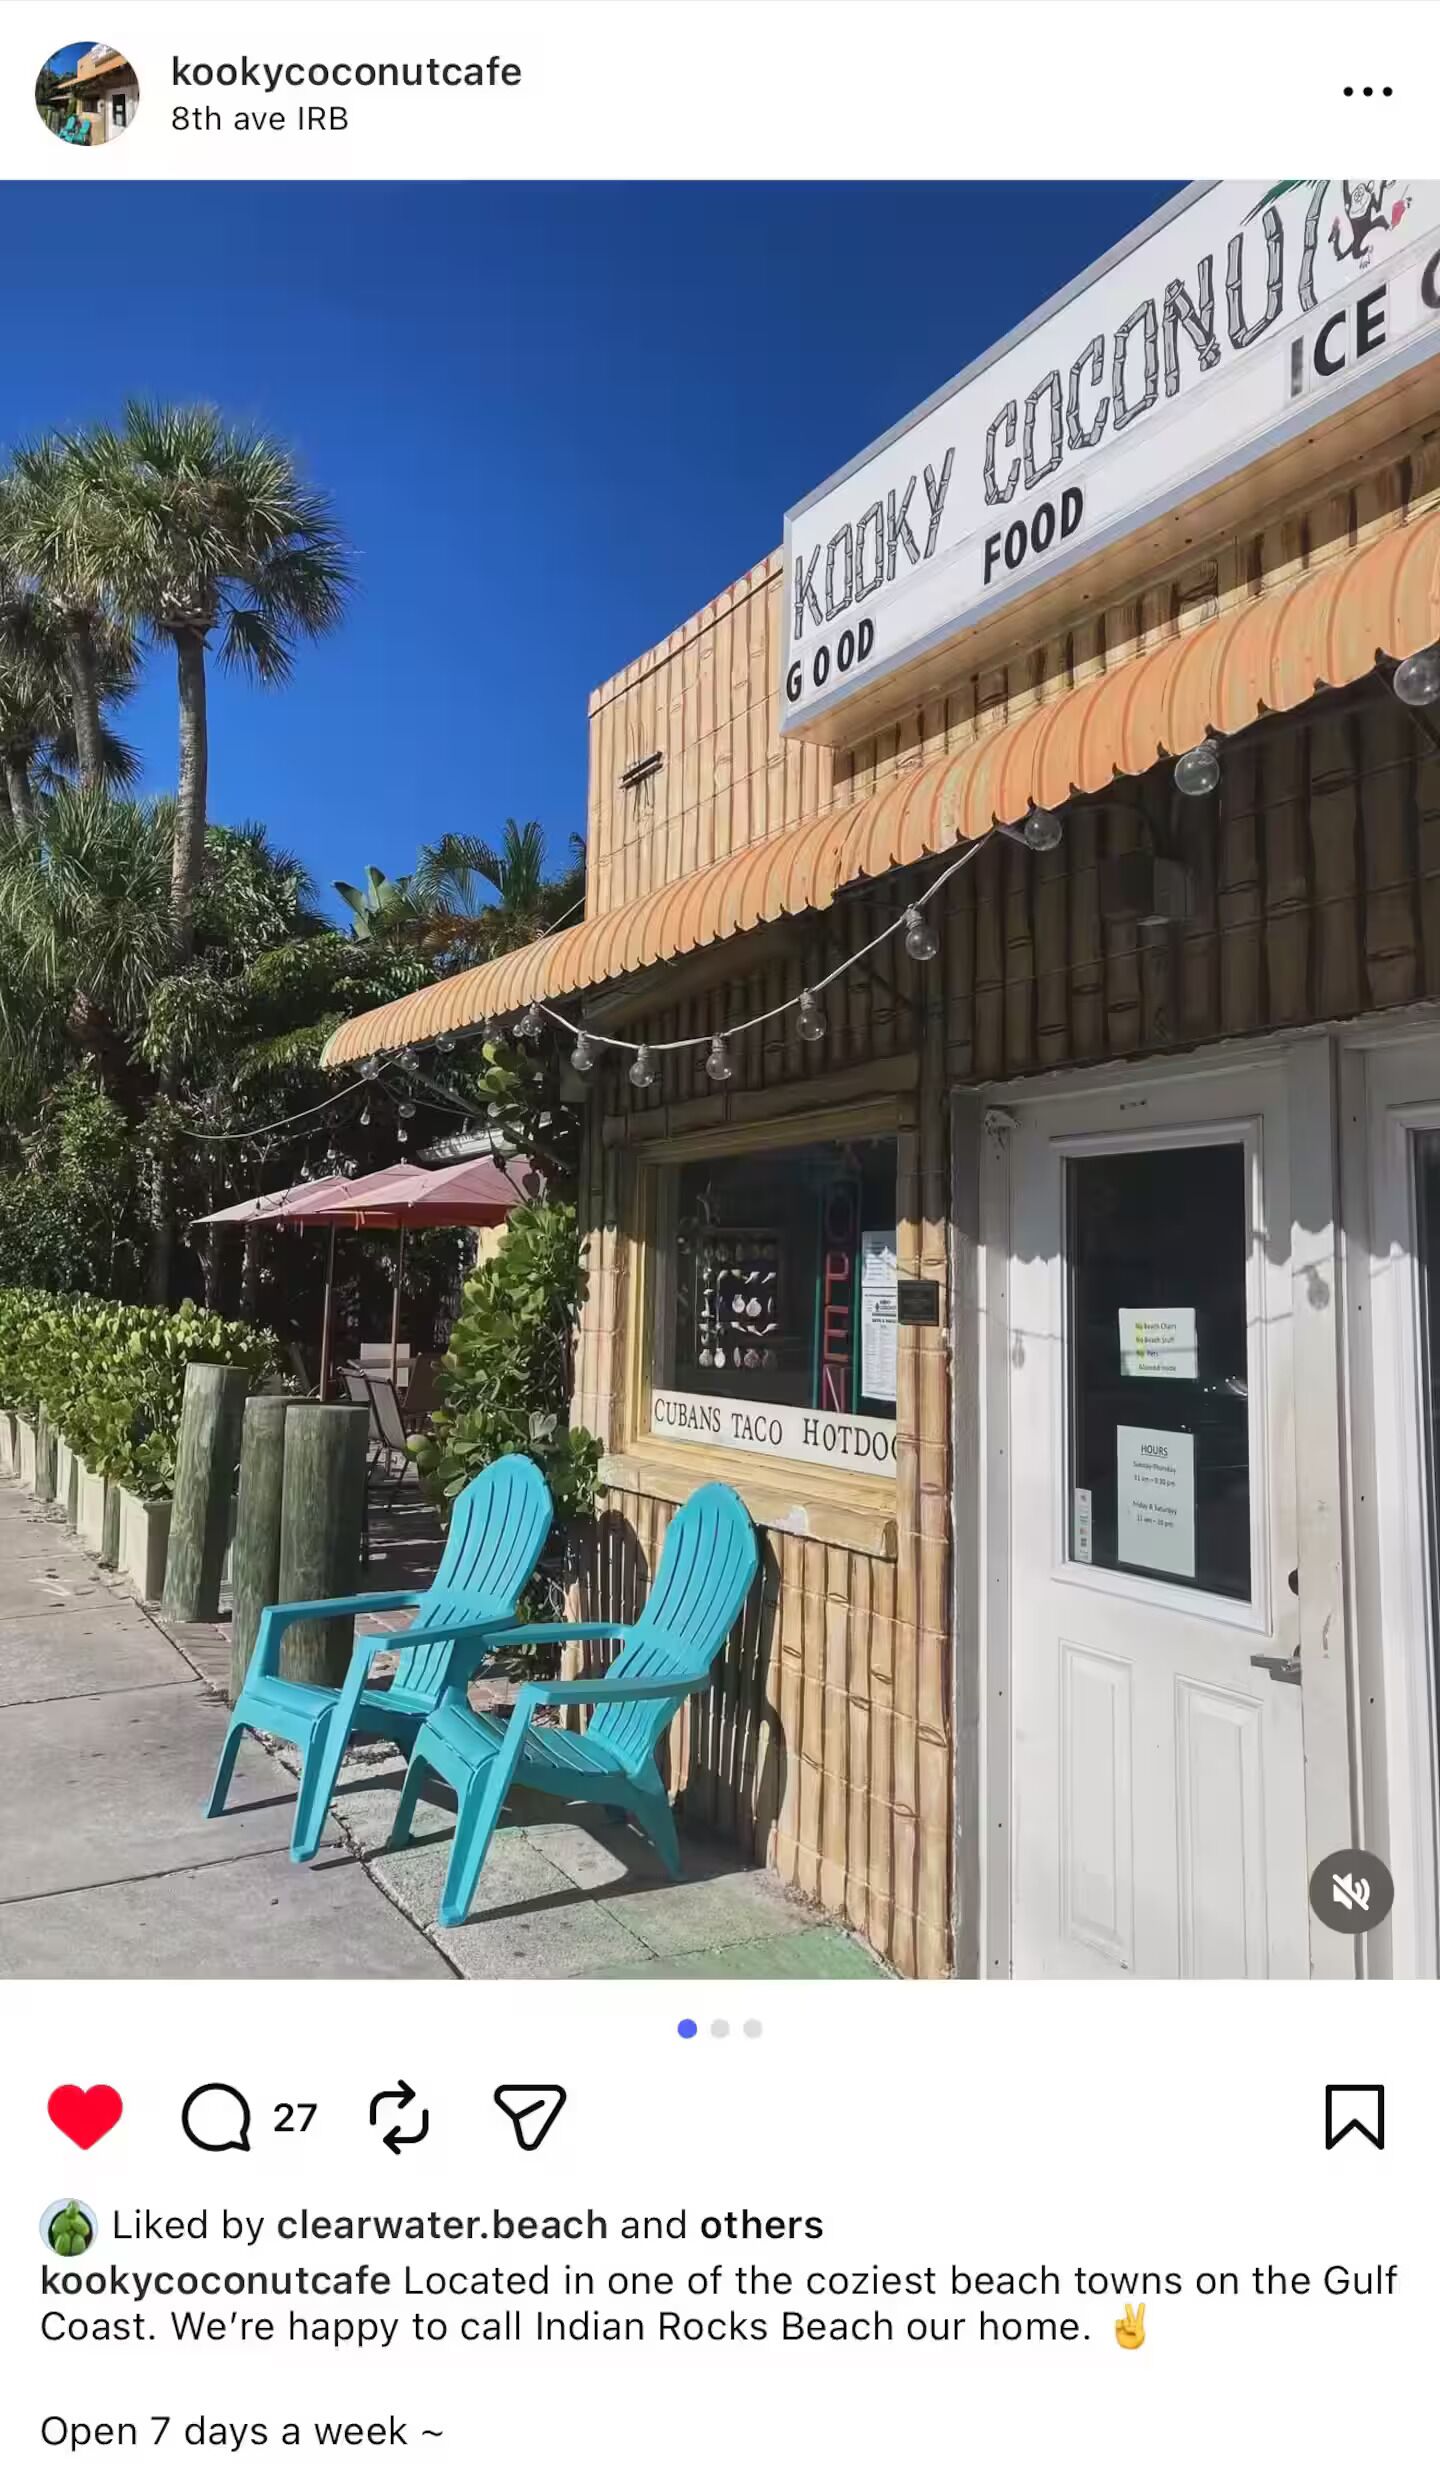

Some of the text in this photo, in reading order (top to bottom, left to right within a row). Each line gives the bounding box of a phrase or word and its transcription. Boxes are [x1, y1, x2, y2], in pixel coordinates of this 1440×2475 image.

[786, 283, 1386, 703] GOOD FOOD ICE
[795, 447, 955, 640] KOOKY
[824, 1187, 852, 1413] OPEN
[654, 1398, 721, 1433] CUBANS
[731, 1412, 783, 1445] TACO
[1140, 1444, 1168, 1457] HOURS
